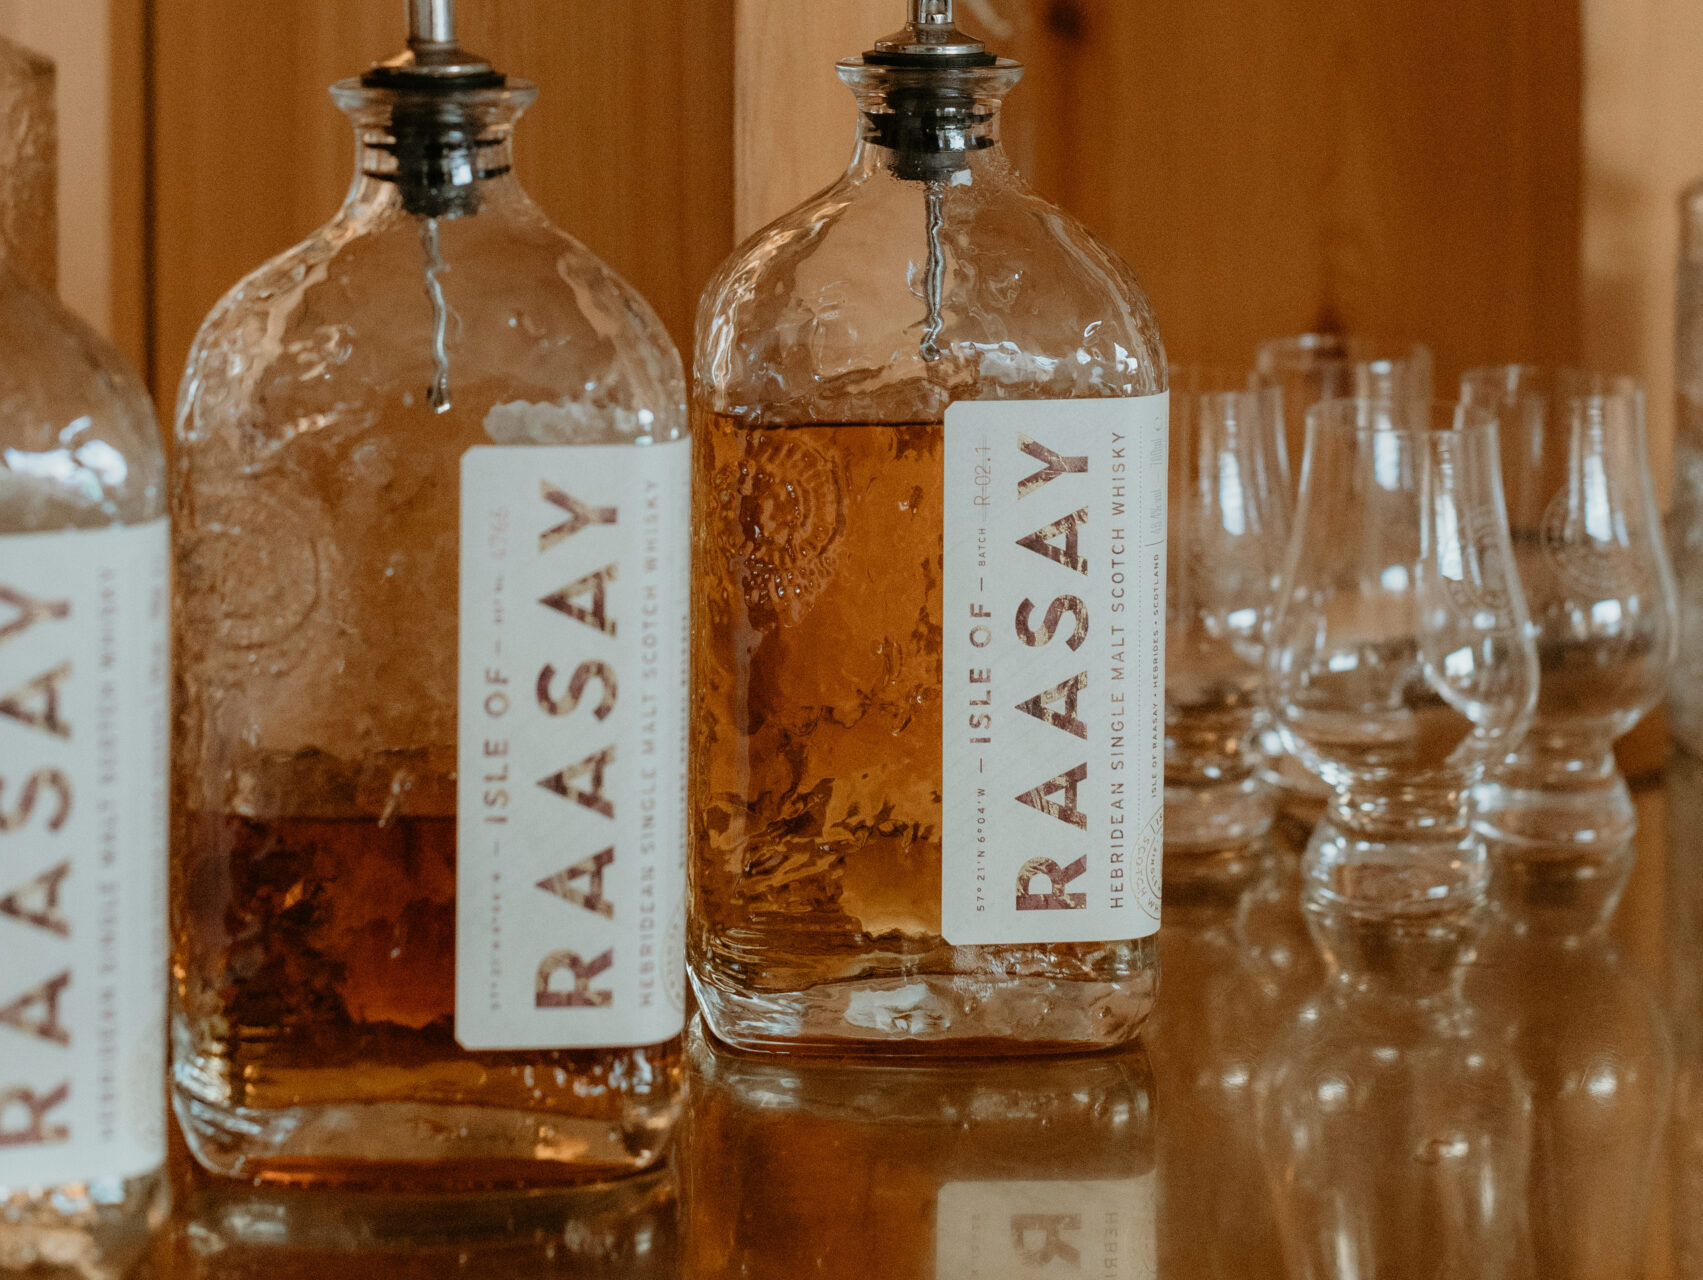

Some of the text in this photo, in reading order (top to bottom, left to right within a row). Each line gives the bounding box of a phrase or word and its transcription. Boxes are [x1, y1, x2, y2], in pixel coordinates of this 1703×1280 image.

[978, 528, 987, 567] BATCH
[1153, 554, 1161, 616] SCOTLAND
[969, 603, 992, 744] ISLE OF
[1014, 433, 1088, 912] RAASAY
[1110, 432, 1126, 909] HEBRIDEAN SINGLE MALT SCOTCH WHISKY
[1152, 630, 1160, 689] HEBRIDES
[484, 667, 510, 825] ISLE OF
[534, 480, 618, 1009] RAASAY
[640, 480, 660, 1007] HEBRIDEAN SINGLE MALT SCOTCH WHISKY
[1151, 754, 1159, 768] OF
[1151, 773, 1159, 799] ISLE
[0, 584, 72, 1149] RAASAY
